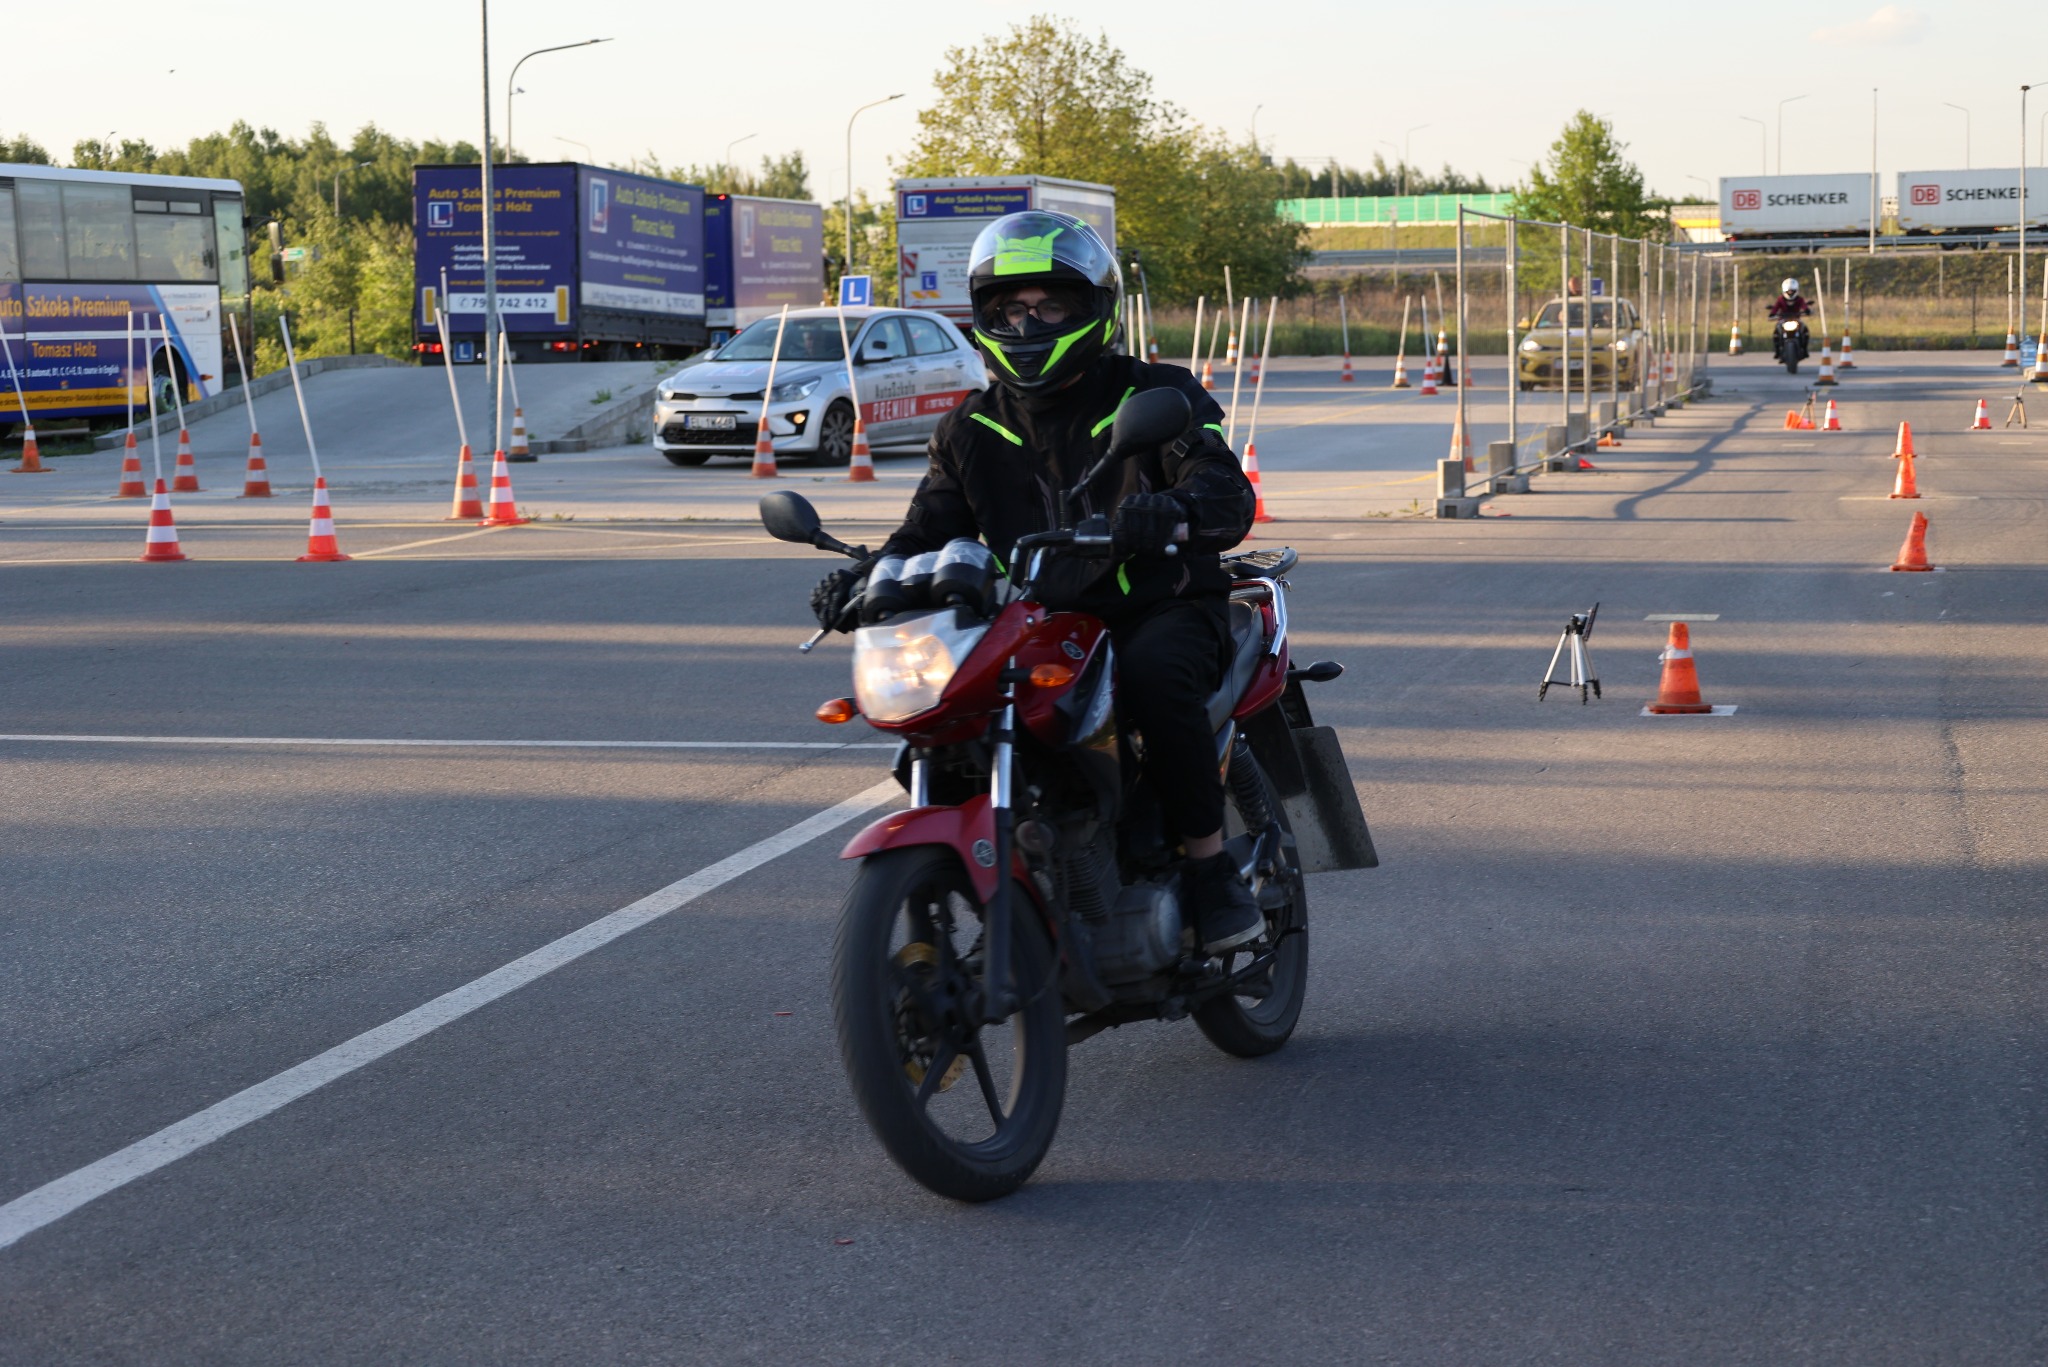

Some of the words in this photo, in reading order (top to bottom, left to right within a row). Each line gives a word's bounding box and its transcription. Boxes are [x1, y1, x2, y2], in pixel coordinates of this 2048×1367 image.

[428, 188, 459, 199] Auto
[462, 187, 502, 199] Szka
[504, 187, 561, 199] Premium
[934, 196, 956, 204] Auto
[985, 194, 1024, 202] Premium
[1735, 193, 1758, 207] DB
[1767, 192, 1848, 206] SCHENKER
[1914, 187, 1937, 202] DB
[1946, 187, 2029, 201] SCHENKER
[456, 202, 502, 212] Tomz
[505, 202, 533, 212] Holz
[953, 205, 985, 213] Tomasz
[849, 281, 862, 302] L
[0, 297, 23, 317] uto
[26, 294, 71, 317] Szkoła
[72, 295, 132, 317] Premium
[499, 298, 521, 308] 742
[524, 298, 548, 308] 412
[31, 341, 73, 358] Tomasz
[73, 341, 97, 358] Holz
[872, 397, 917, 422] PREMIUM
